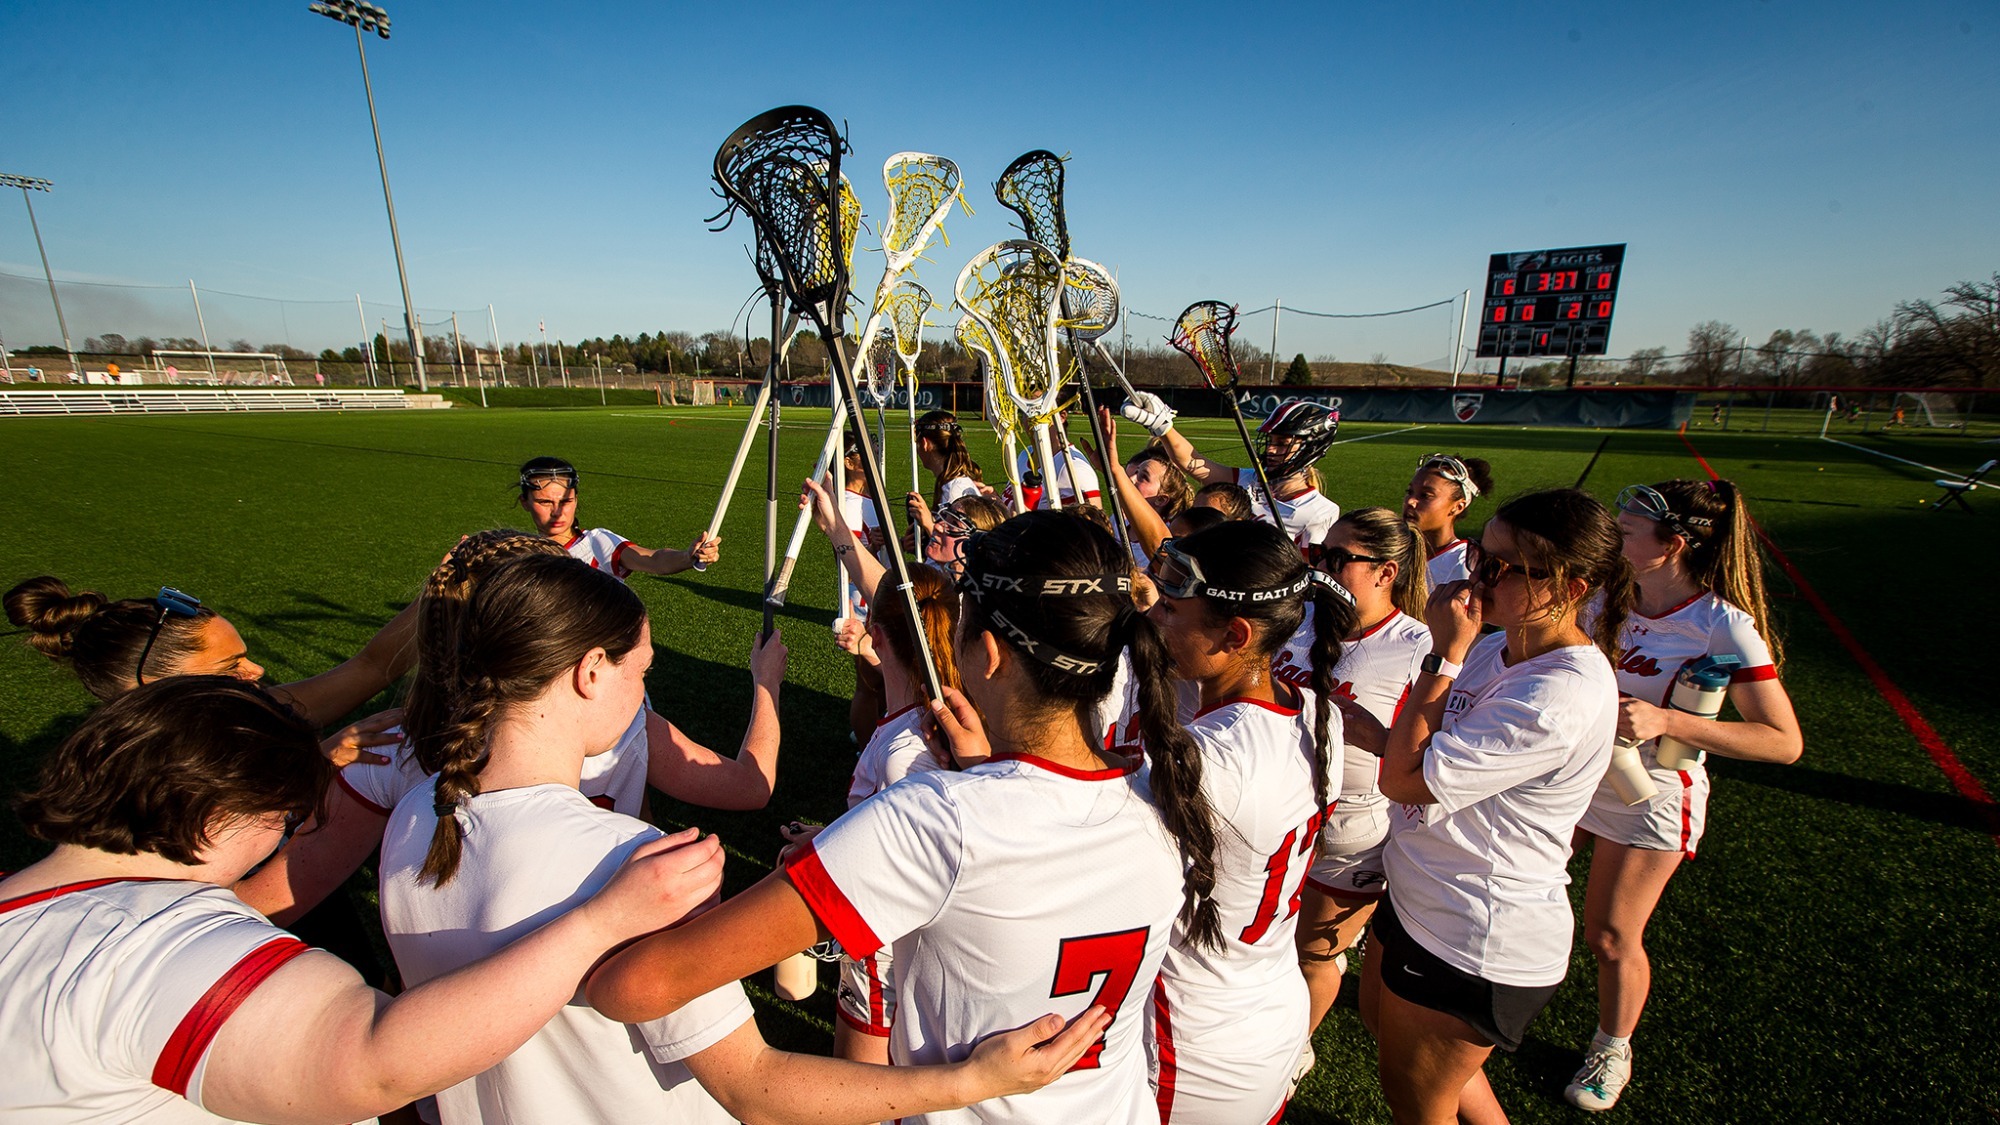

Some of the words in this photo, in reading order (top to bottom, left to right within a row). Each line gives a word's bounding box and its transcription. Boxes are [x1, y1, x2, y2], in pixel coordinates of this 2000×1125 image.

[1551, 253, 1603, 266] EAGLES
[1586, 265, 1616, 273] GUEST
[1503, 279, 1515, 295] 6
[1597, 272, 1611, 290] 0
[1494, 306, 1506, 322] 8
[1522, 305, 1534, 321] 0
[1567, 302, 1580, 318] 2
[1598, 301, 1611, 317] 0
[1541, 333, 1547, 346] 1
[1249, 394, 1343, 414] SOR
[1664, 512, 1681, 521] TX
[1688, 516, 1713, 526] STX
[1672, 523, 1694, 542] STX
[964, 570, 985, 604] TX
[982, 573, 1024, 593] STX
[1041, 578, 1104, 594] STX
[1206, 588, 1246, 601] GAIT
[1252, 587, 1289, 601] GAIT
[990, 609, 1039, 655] STX
[1617, 645, 1663, 677] les
[1049, 925, 1151, 1070] 7
